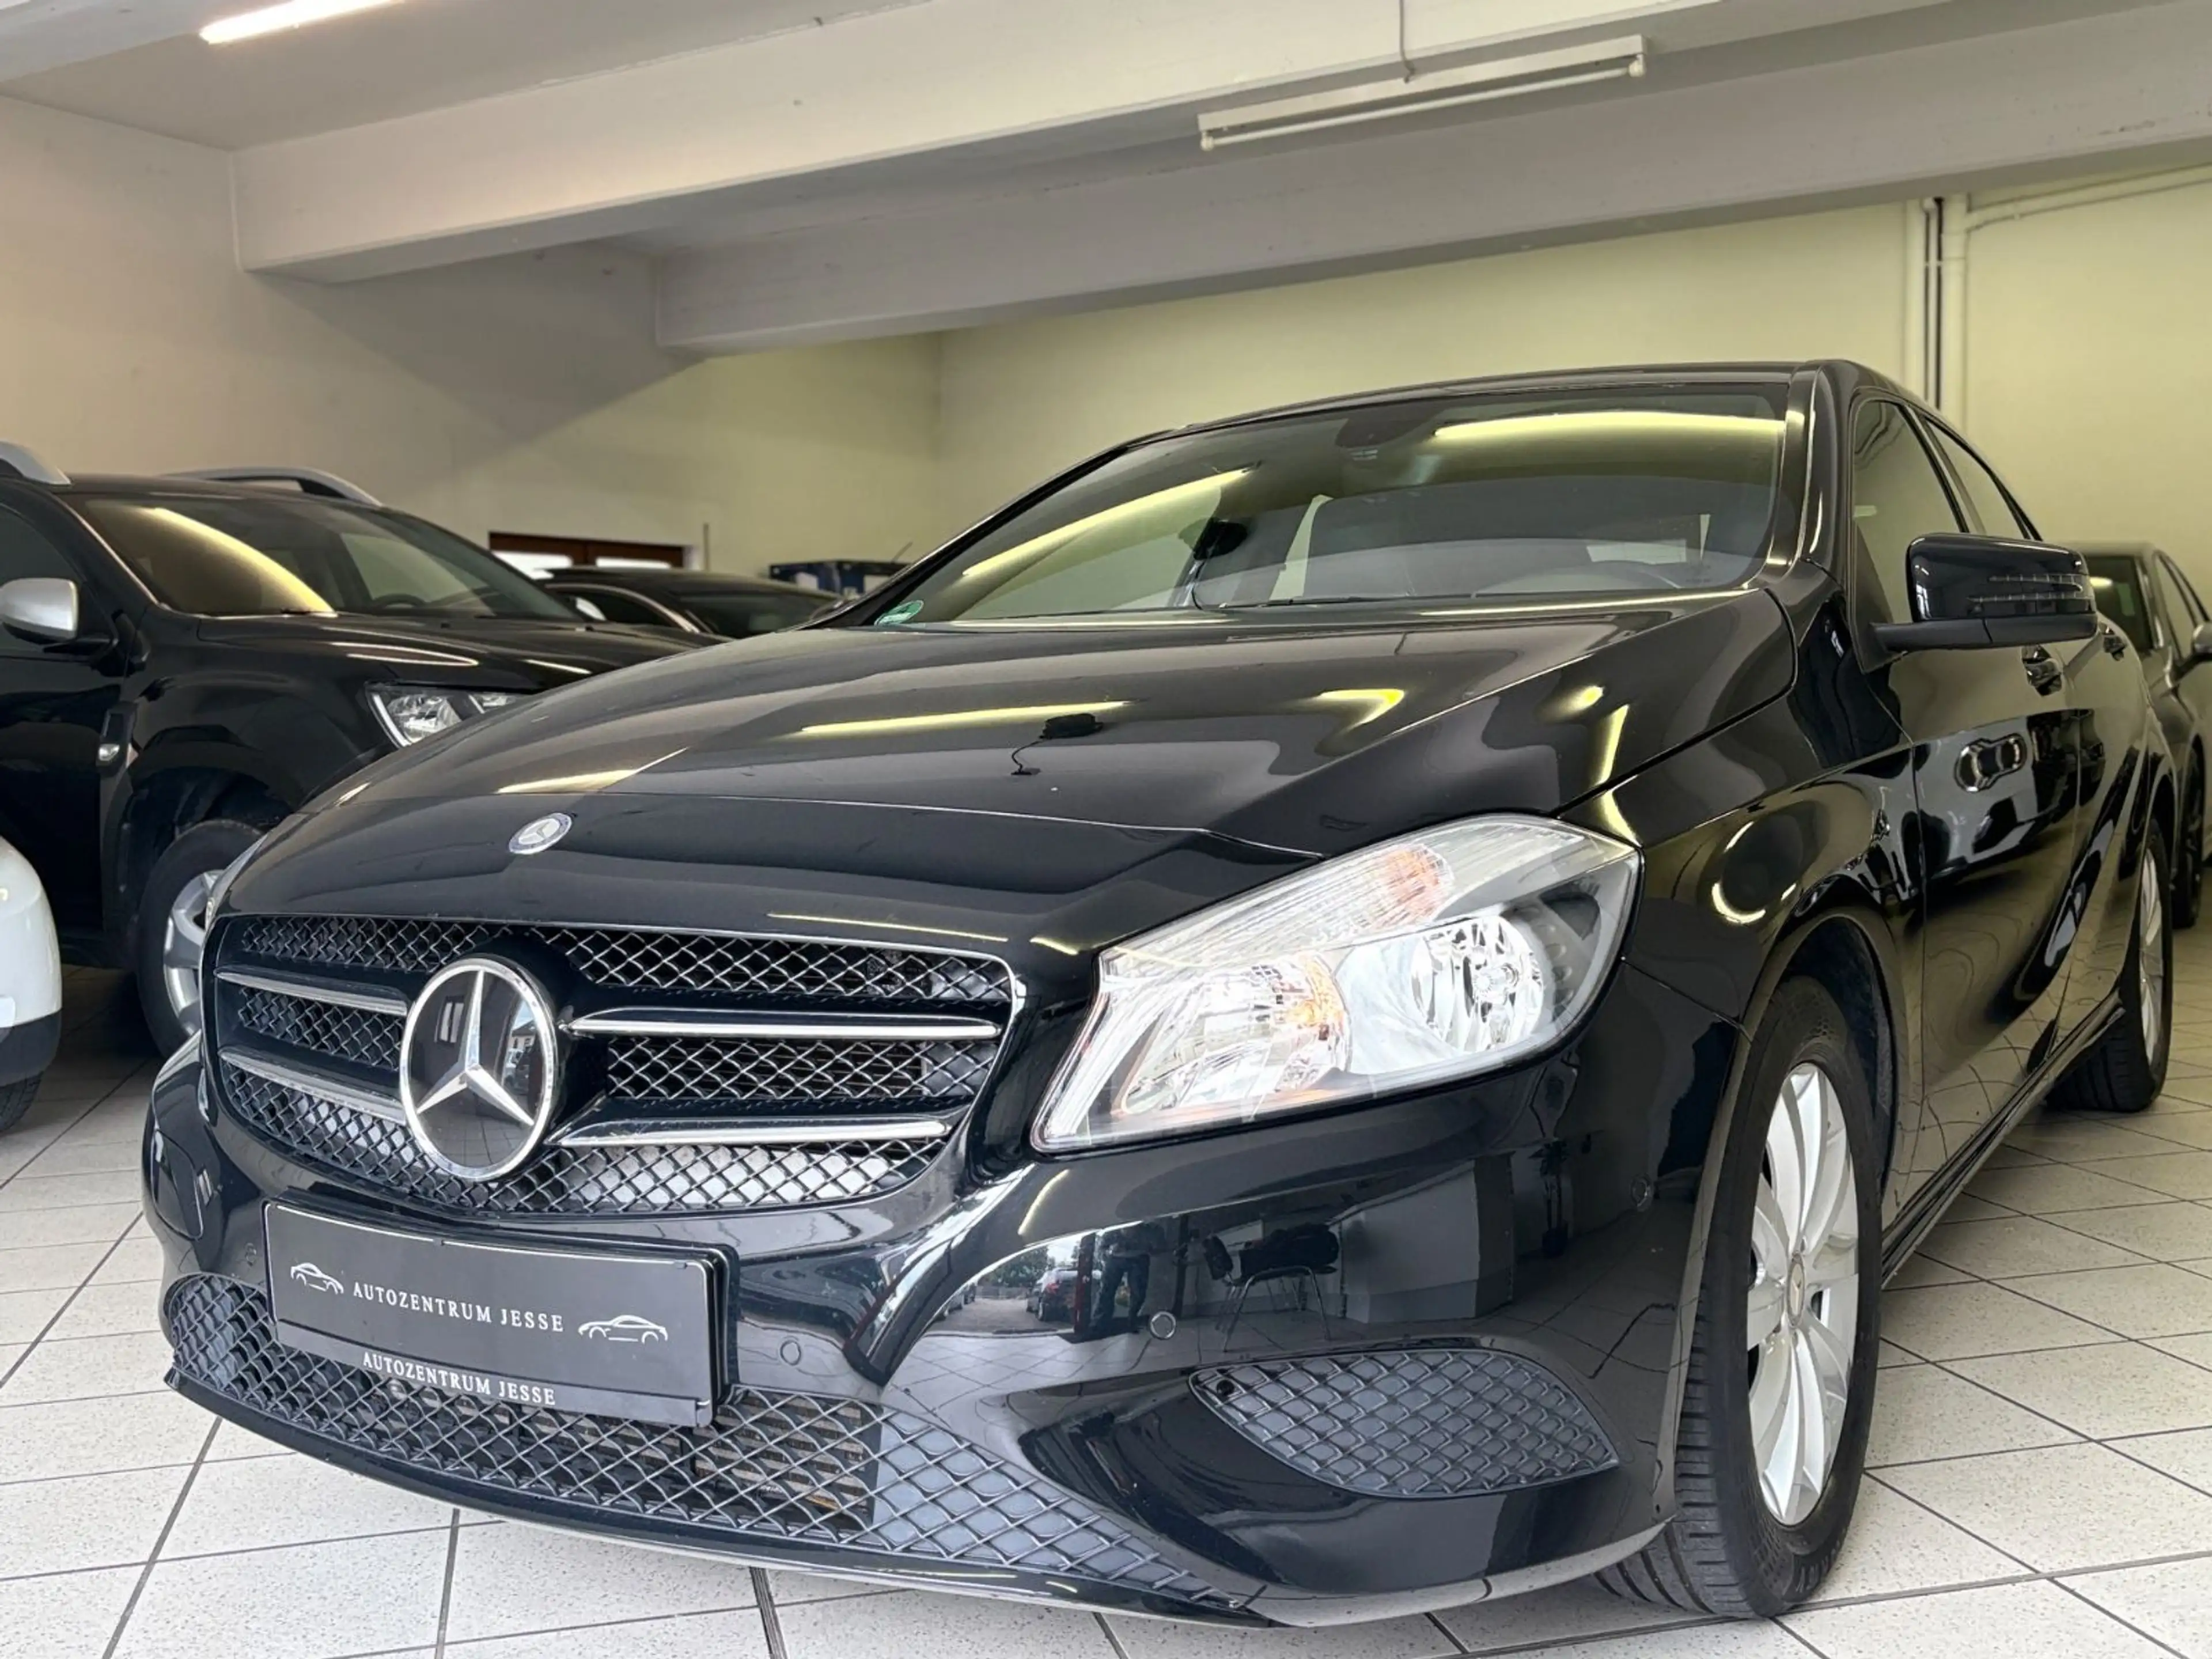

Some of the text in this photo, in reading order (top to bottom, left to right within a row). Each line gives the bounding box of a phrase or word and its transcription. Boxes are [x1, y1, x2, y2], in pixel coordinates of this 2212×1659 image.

[353, 1282, 563, 1332] AUTOZENTRUM JESSE
[363, 1351, 555, 1406] AUTOZENTRUM JESSE
